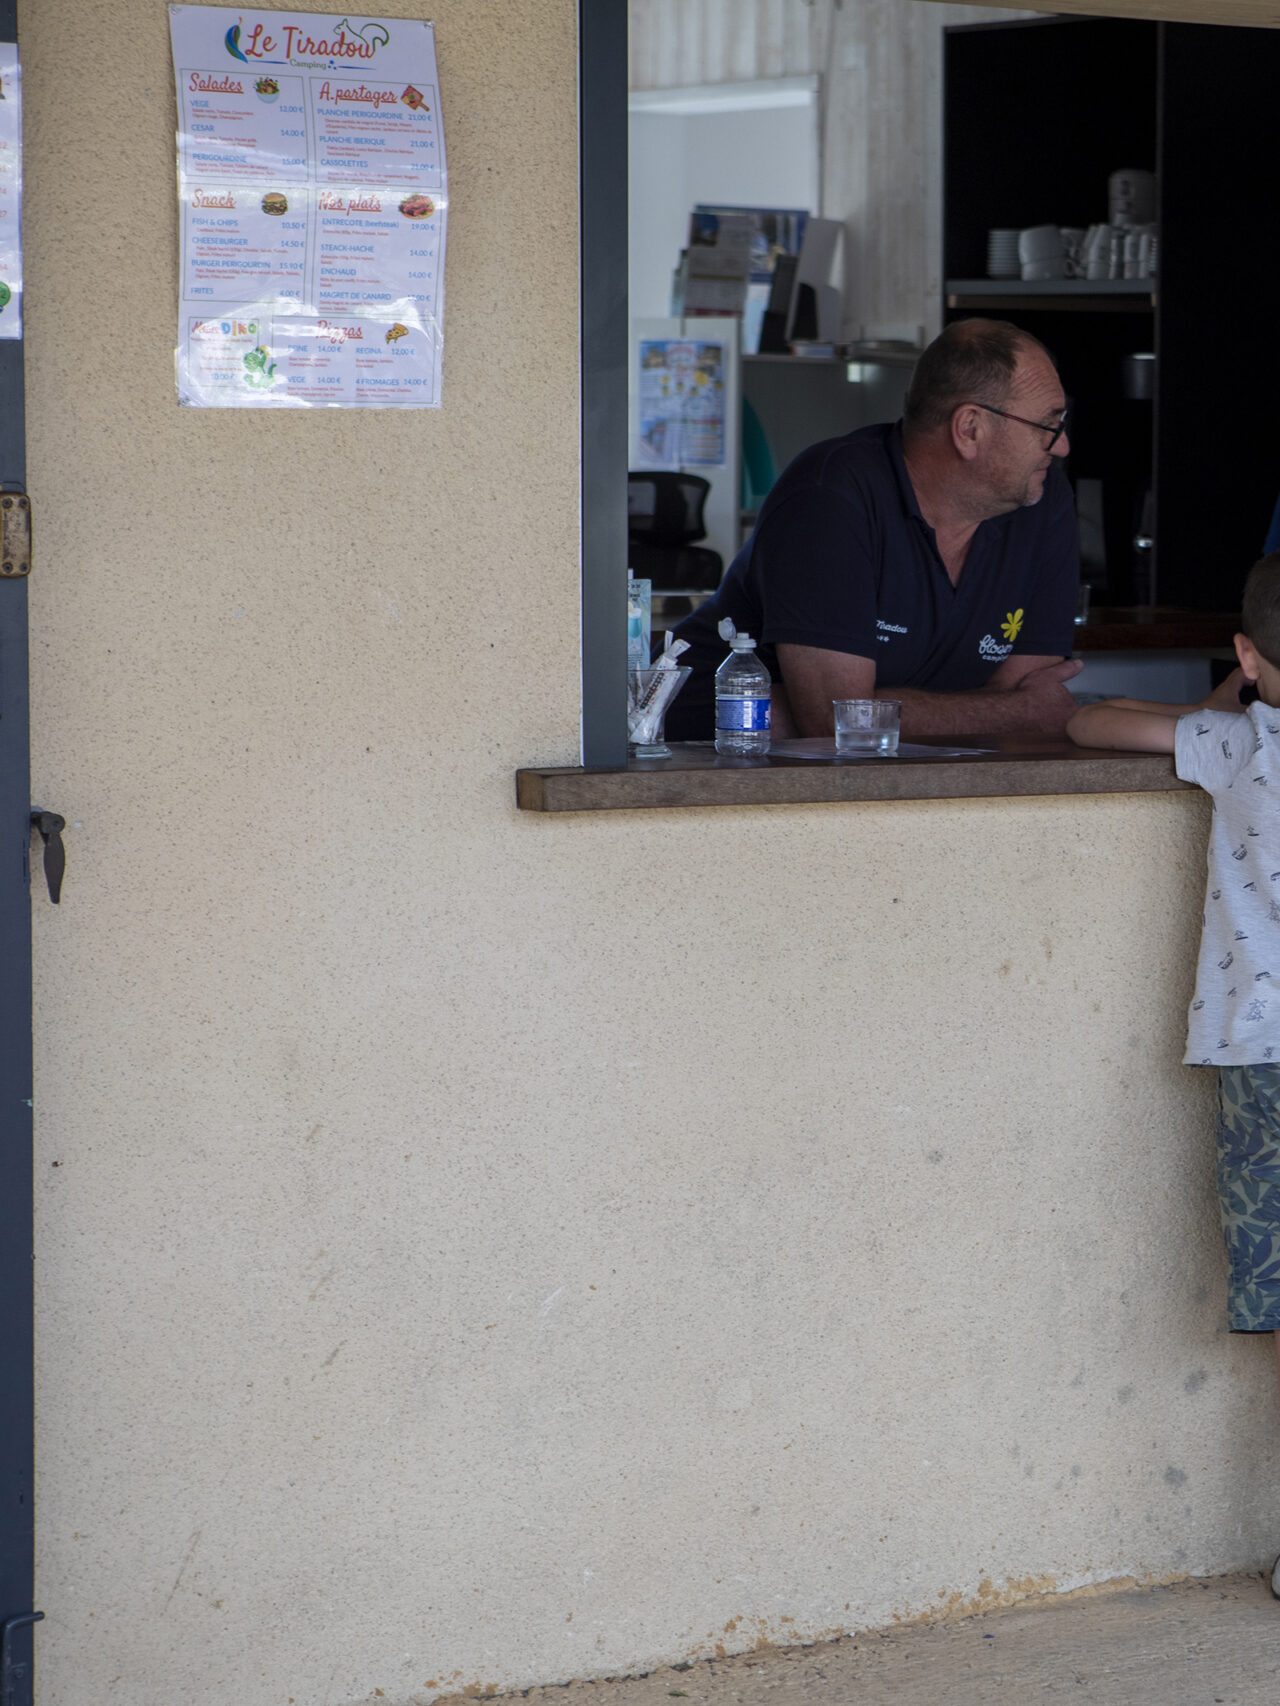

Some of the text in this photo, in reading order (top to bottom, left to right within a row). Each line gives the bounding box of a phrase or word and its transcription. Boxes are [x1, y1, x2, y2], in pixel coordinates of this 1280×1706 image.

[244, 24, 376, 59] Le Tiradou
[289, 59, 327, 71] Camping
[189, 72, 243, 93] Salades
[192, 188, 236, 209] Snack
[346, 194, 382, 216] plats
[316, 320, 363, 344] Pizzas
